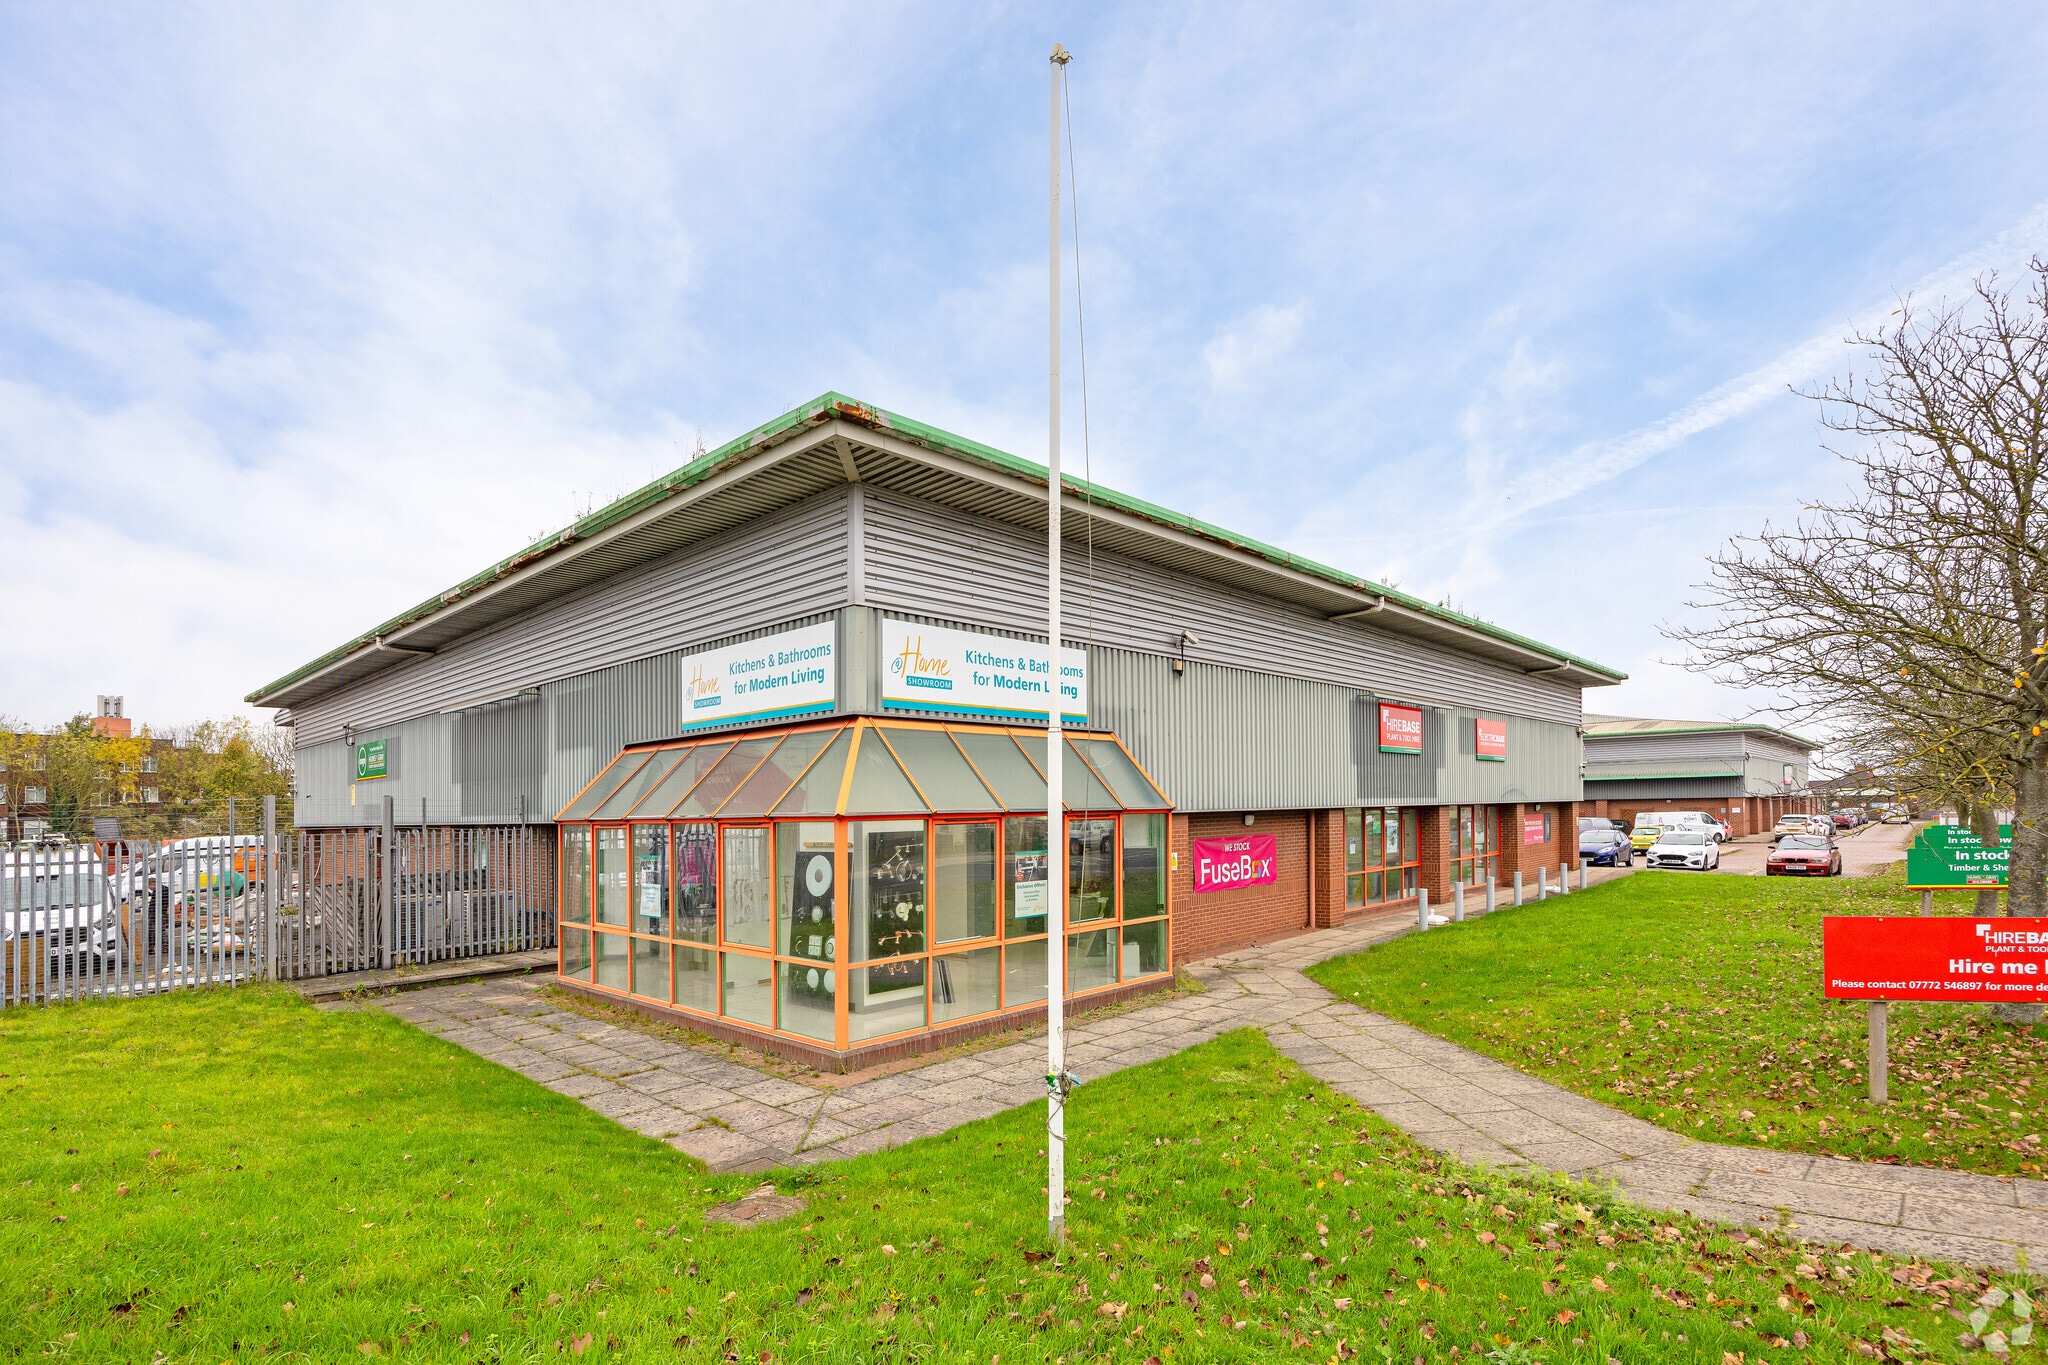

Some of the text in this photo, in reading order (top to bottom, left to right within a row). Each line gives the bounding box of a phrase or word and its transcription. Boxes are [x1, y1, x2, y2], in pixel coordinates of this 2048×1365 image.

[729, 644, 831, 676] Kitchens & Bathrooms
[965, 649, 1015, 670] Kitchens
[1018, 657, 1026, 670] &
[734, 668, 825, 695] for Modern Living
[907, 677, 952, 689] SHOWROOM
[973, 671, 1078, 699] for Modern Ling
[694, 696, 721, 708] SHOWROOM
[1386, 718, 1420, 734] HIREBASE
[1386, 733, 1399, 741] PLANT
[1960, 836, 1982, 844] stoc
[1224, 842, 1250, 852] WE STOCK
[1955, 850, 1970, 860] In
[1200, 854, 1270, 885] FuseBox
[1948, 864, 2009, 872] Timber & She
[1985, 931, 2048, 944] HIREBA
[1949, 958, 1995, 974] Hire
[2002, 962, 2038, 975] me
[1832, 979, 1865, 988] Please
[1867, 981, 1906, 989] contact
[1909, 981, 1941, 989] 07772
[1944, 982, 1982, 990] 546897
[1985, 982, 2002, 990] for
[2004, 983, 2033, 991] more
